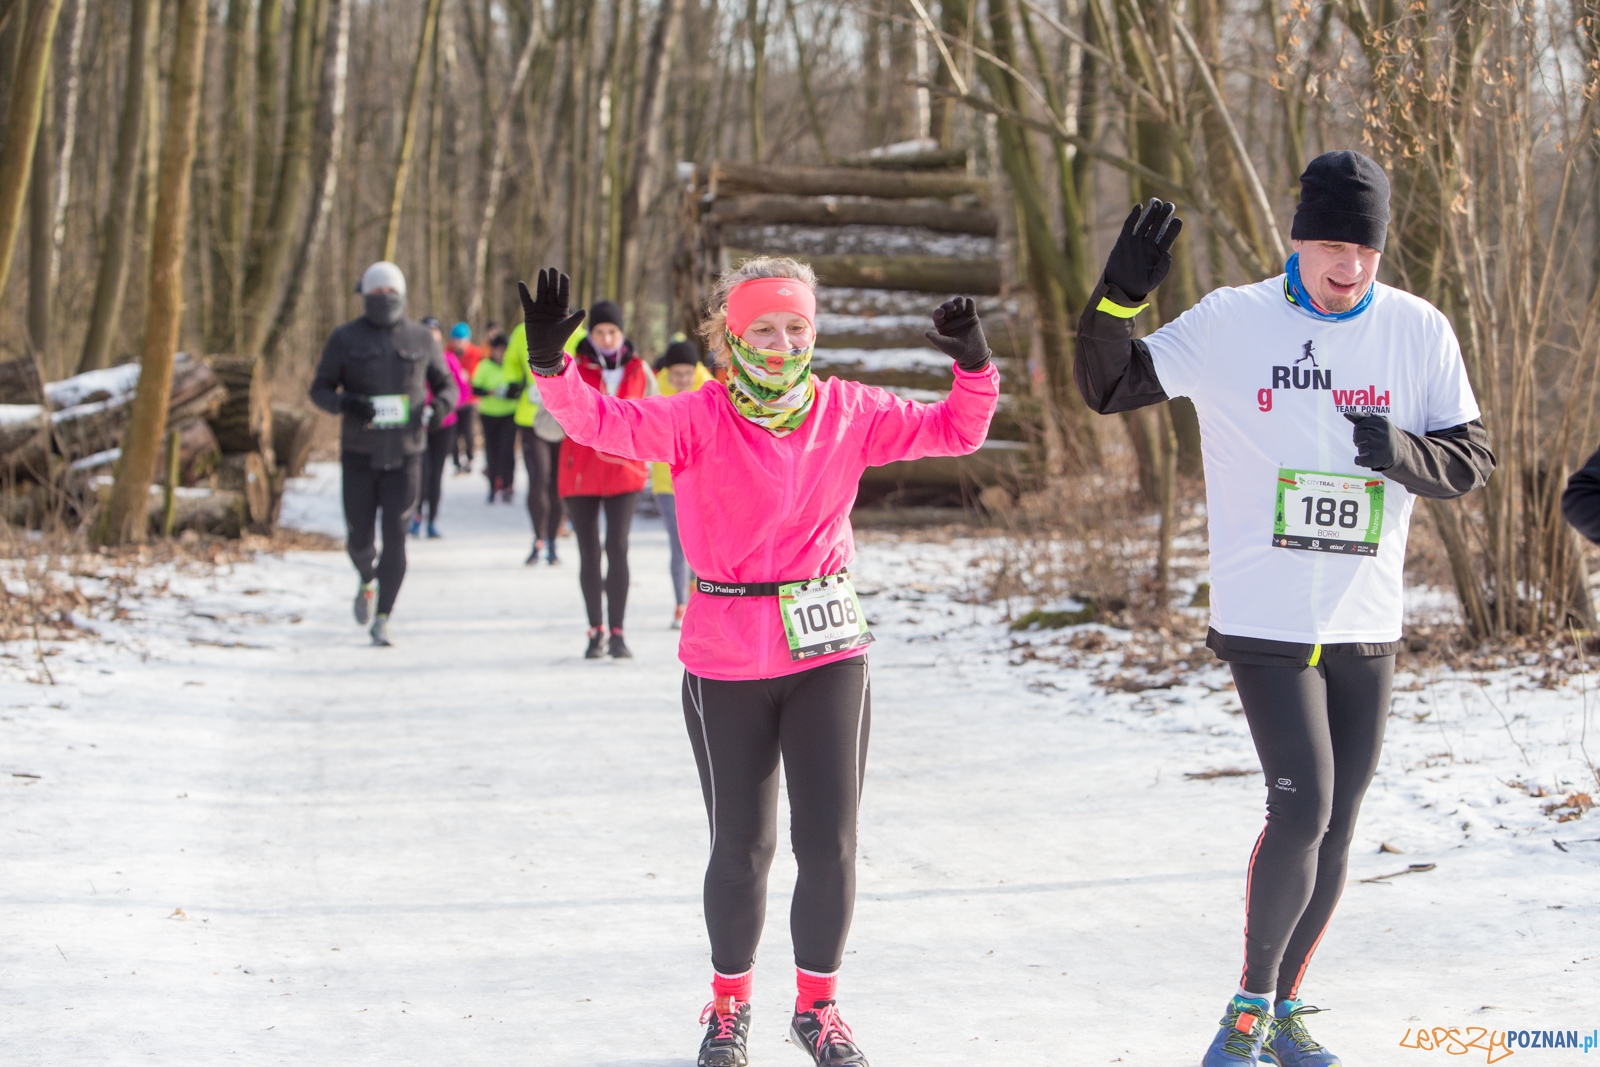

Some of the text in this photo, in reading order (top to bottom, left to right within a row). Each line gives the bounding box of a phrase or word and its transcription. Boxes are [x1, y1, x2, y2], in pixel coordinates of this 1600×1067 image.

[1272, 365, 1332, 390] RUN
[1332, 385, 1390, 406] wald
[1361, 406, 1390, 414] POZNAN
[1301, 496, 1359, 529] 188
[1317, 529, 1340, 538] BORKI
[715, 585, 746, 596] Kalenji
[794, 596, 858, 635] 1008
